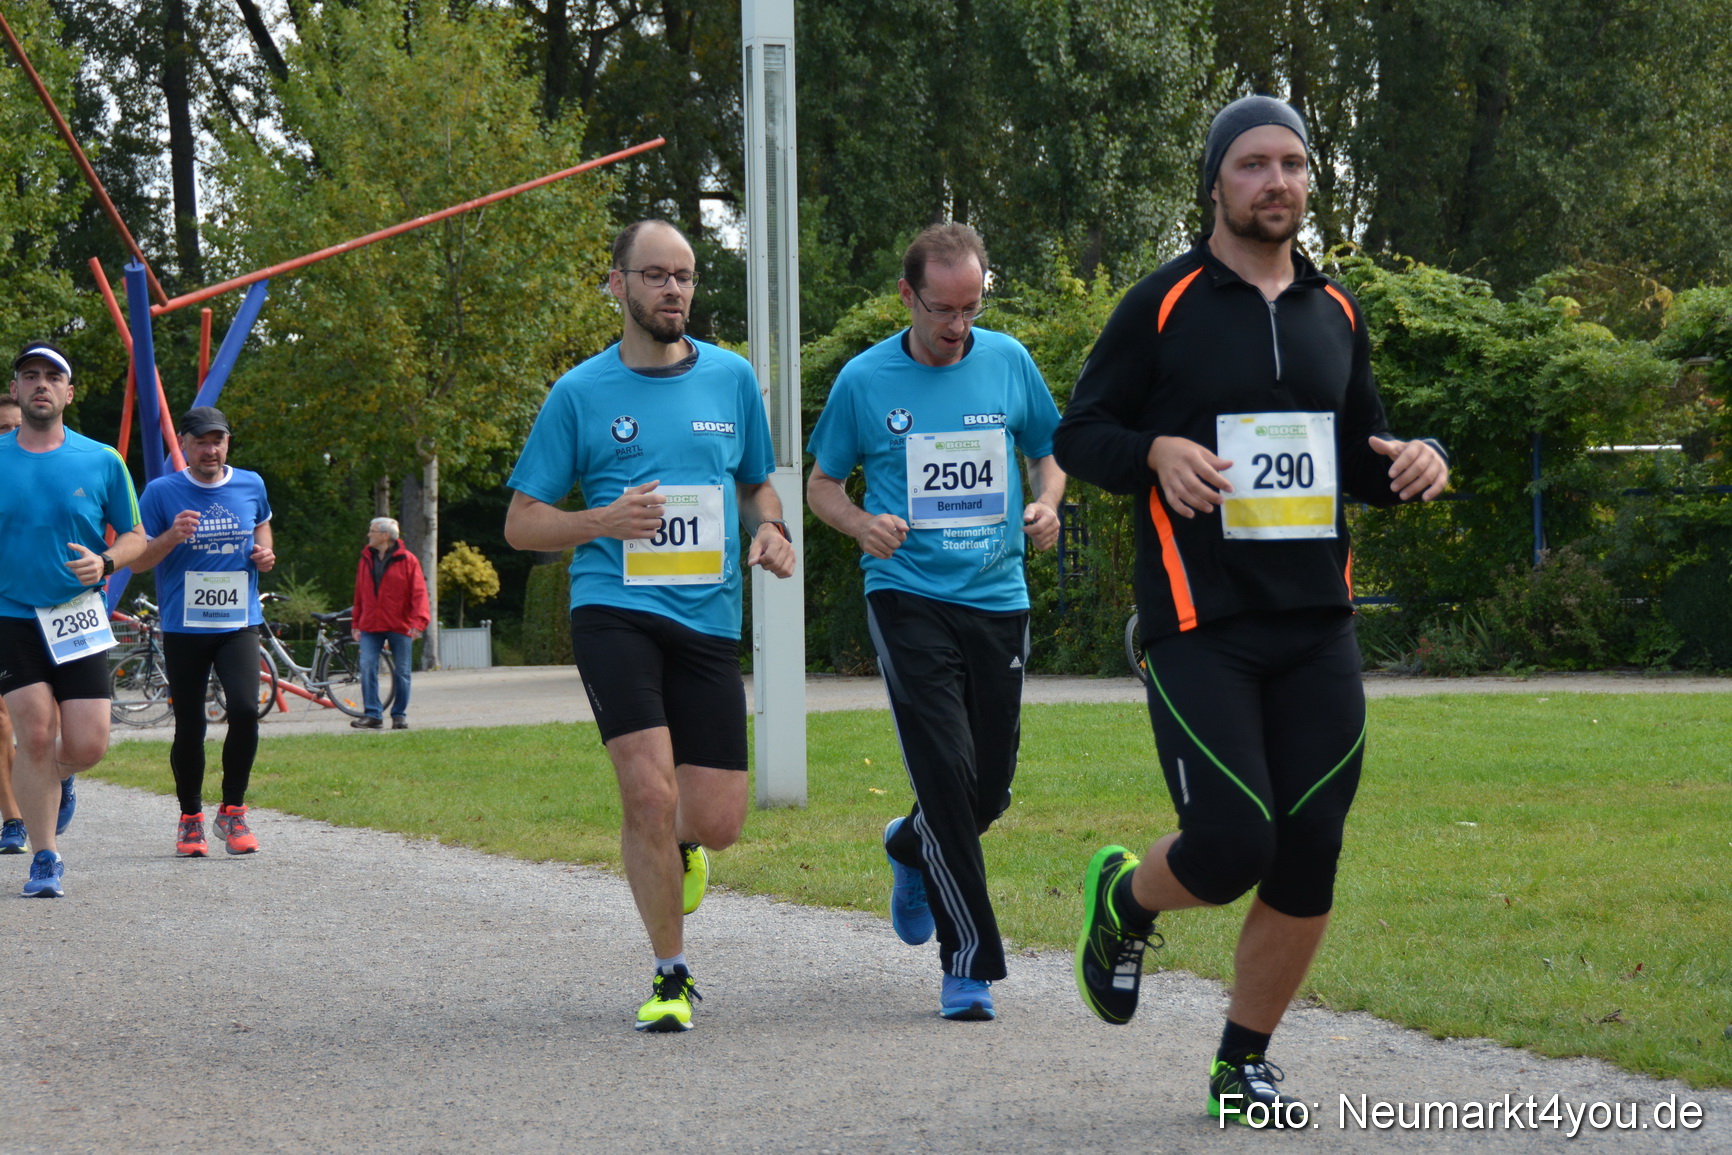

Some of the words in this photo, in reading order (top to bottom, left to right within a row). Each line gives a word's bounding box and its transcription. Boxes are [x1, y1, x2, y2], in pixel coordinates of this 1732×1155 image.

[963, 413, 1007, 426] BOCK
[691, 420, 736, 434] BOCK
[1268, 425, 1307, 435] BOCK
[889, 437, 906, 446] PAR
[945, 440, 980, 449] BOCK
[615, 444, 643, 456] PARTL
[923, 460, 993, 491] 2504
[1251, 452, 1314, 489] 290
[665, 495, 699, 503] BOCK
[937, 498, 982, 512] Bernhard
[196, 530, 231, 538] Neumarkter
[650, 516, 699, 547] 301
[943, 526, 997, 538] Neumarkter
[942, 539, 990, 550] Stadtlauf
[194, 588, 238, 606] 2604
[52, 608, 99, 639] 2388
